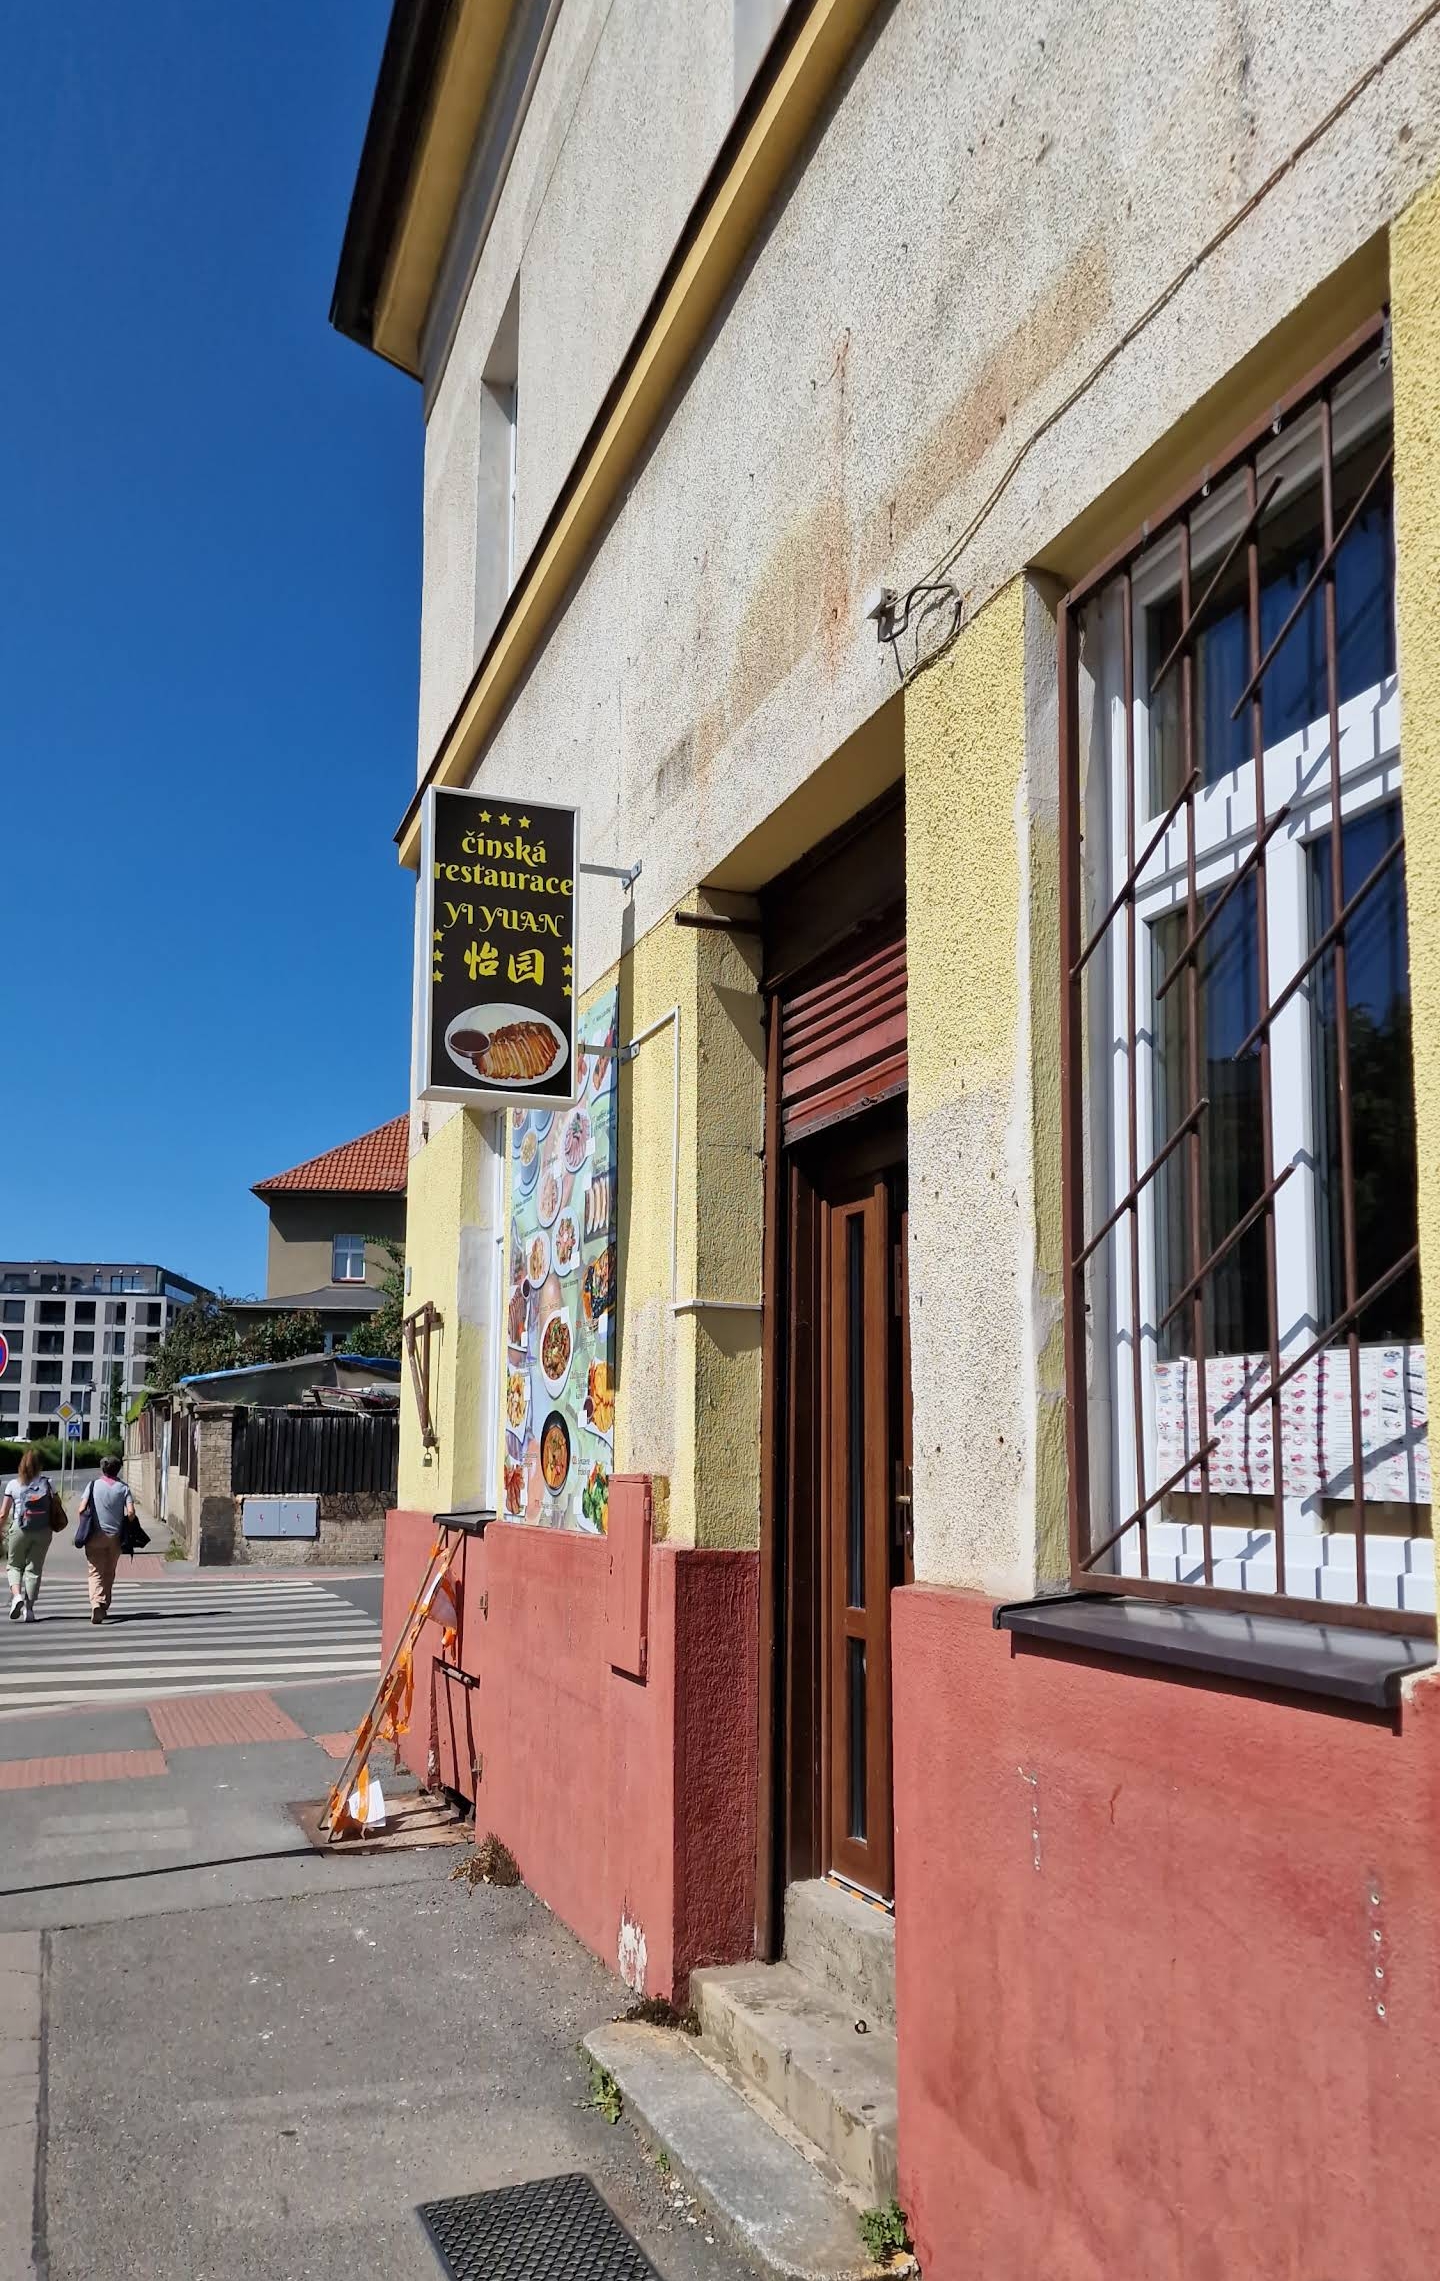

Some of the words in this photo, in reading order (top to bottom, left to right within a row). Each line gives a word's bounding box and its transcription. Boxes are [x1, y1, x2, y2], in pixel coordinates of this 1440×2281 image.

[461, 830, 547, 868] čínská
[434, 862, 573, 896] restaurace
[443, 901, 474, 929] YI
[478, 905, 565, 937] YUAN
[463, 940, 545, 986] 怡园
